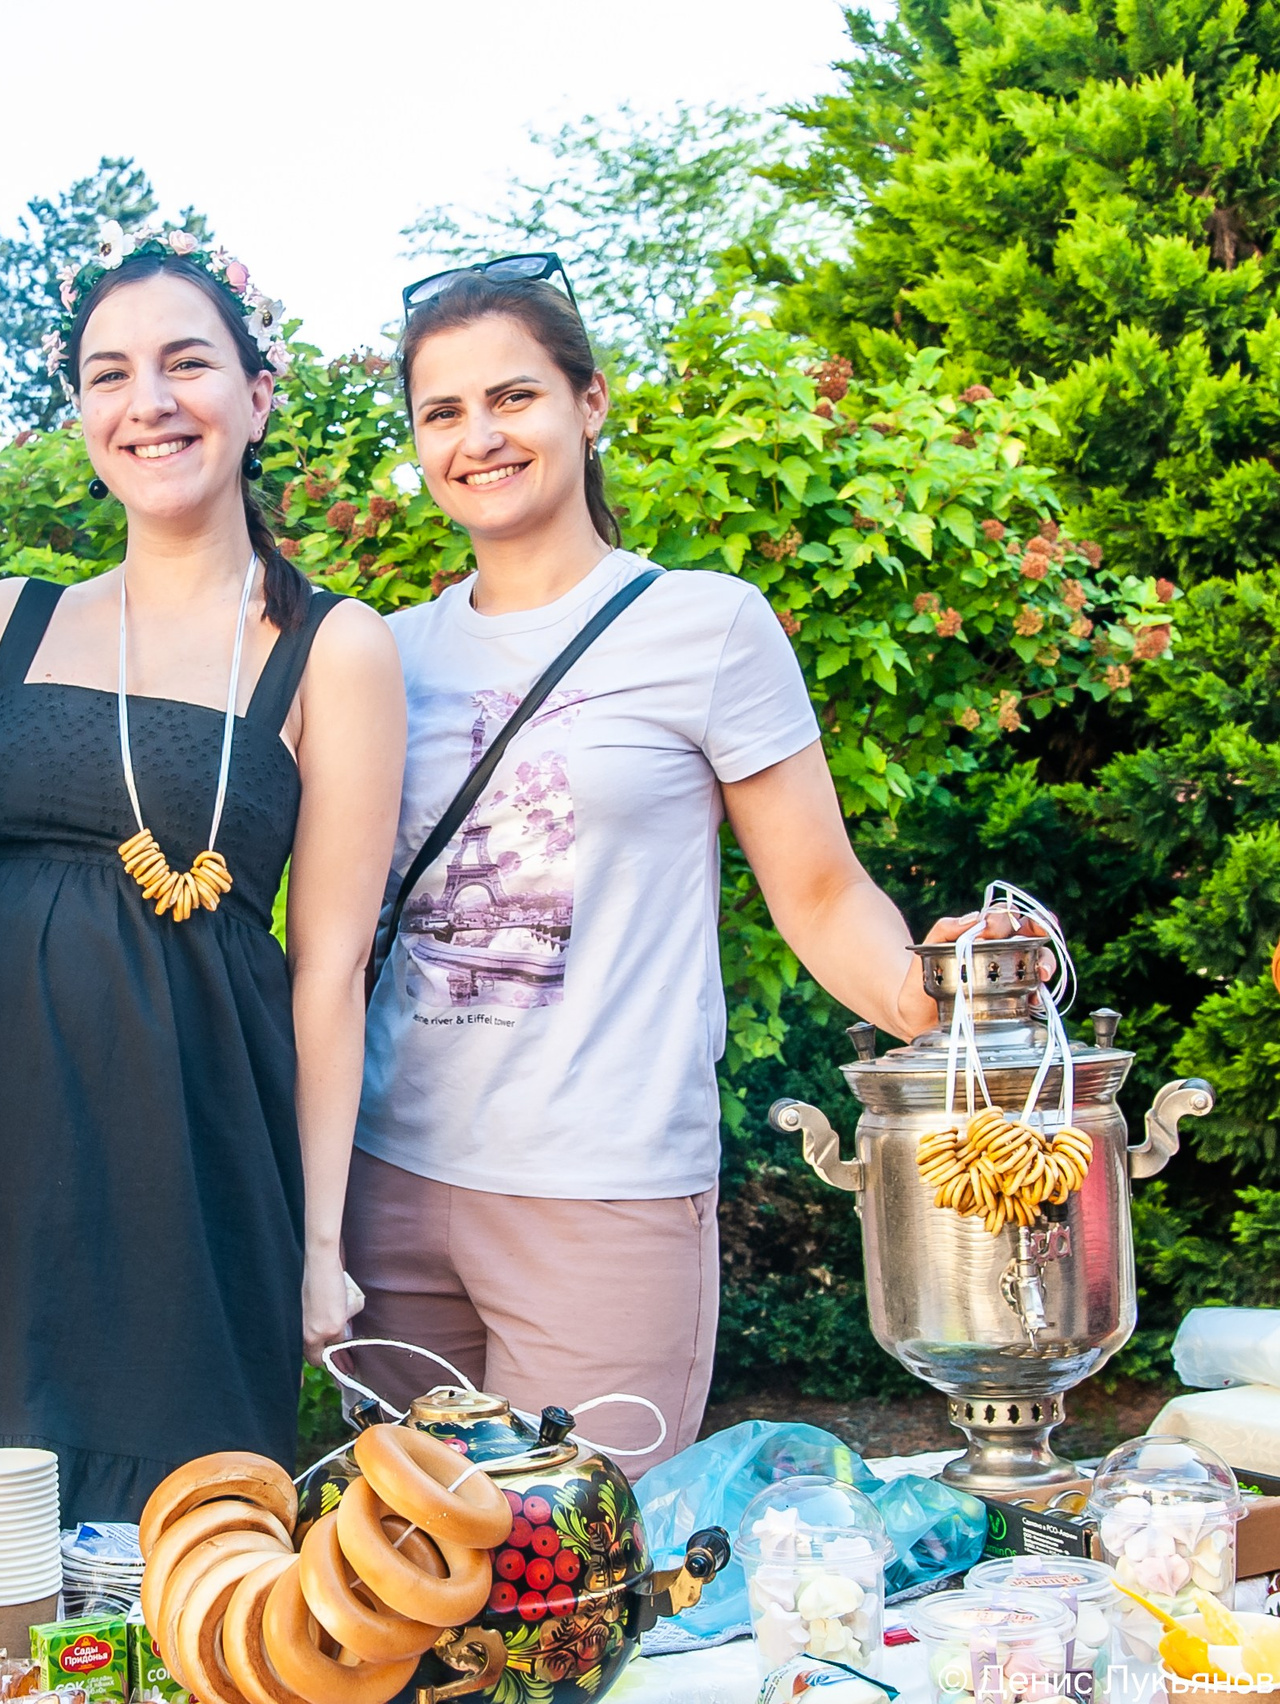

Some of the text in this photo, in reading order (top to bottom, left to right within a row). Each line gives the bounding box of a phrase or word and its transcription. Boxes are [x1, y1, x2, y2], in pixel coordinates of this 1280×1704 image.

[431, 1017, 453, 1025] river
[456, 1015, 464, 1025] &
[467, 1013, 493, 1025] Eiffel
[494, 1017, 516, 1028] tower
[73, 1645, 99, 1657] Сады
[64, 1652, 109, 1667] Придонья
